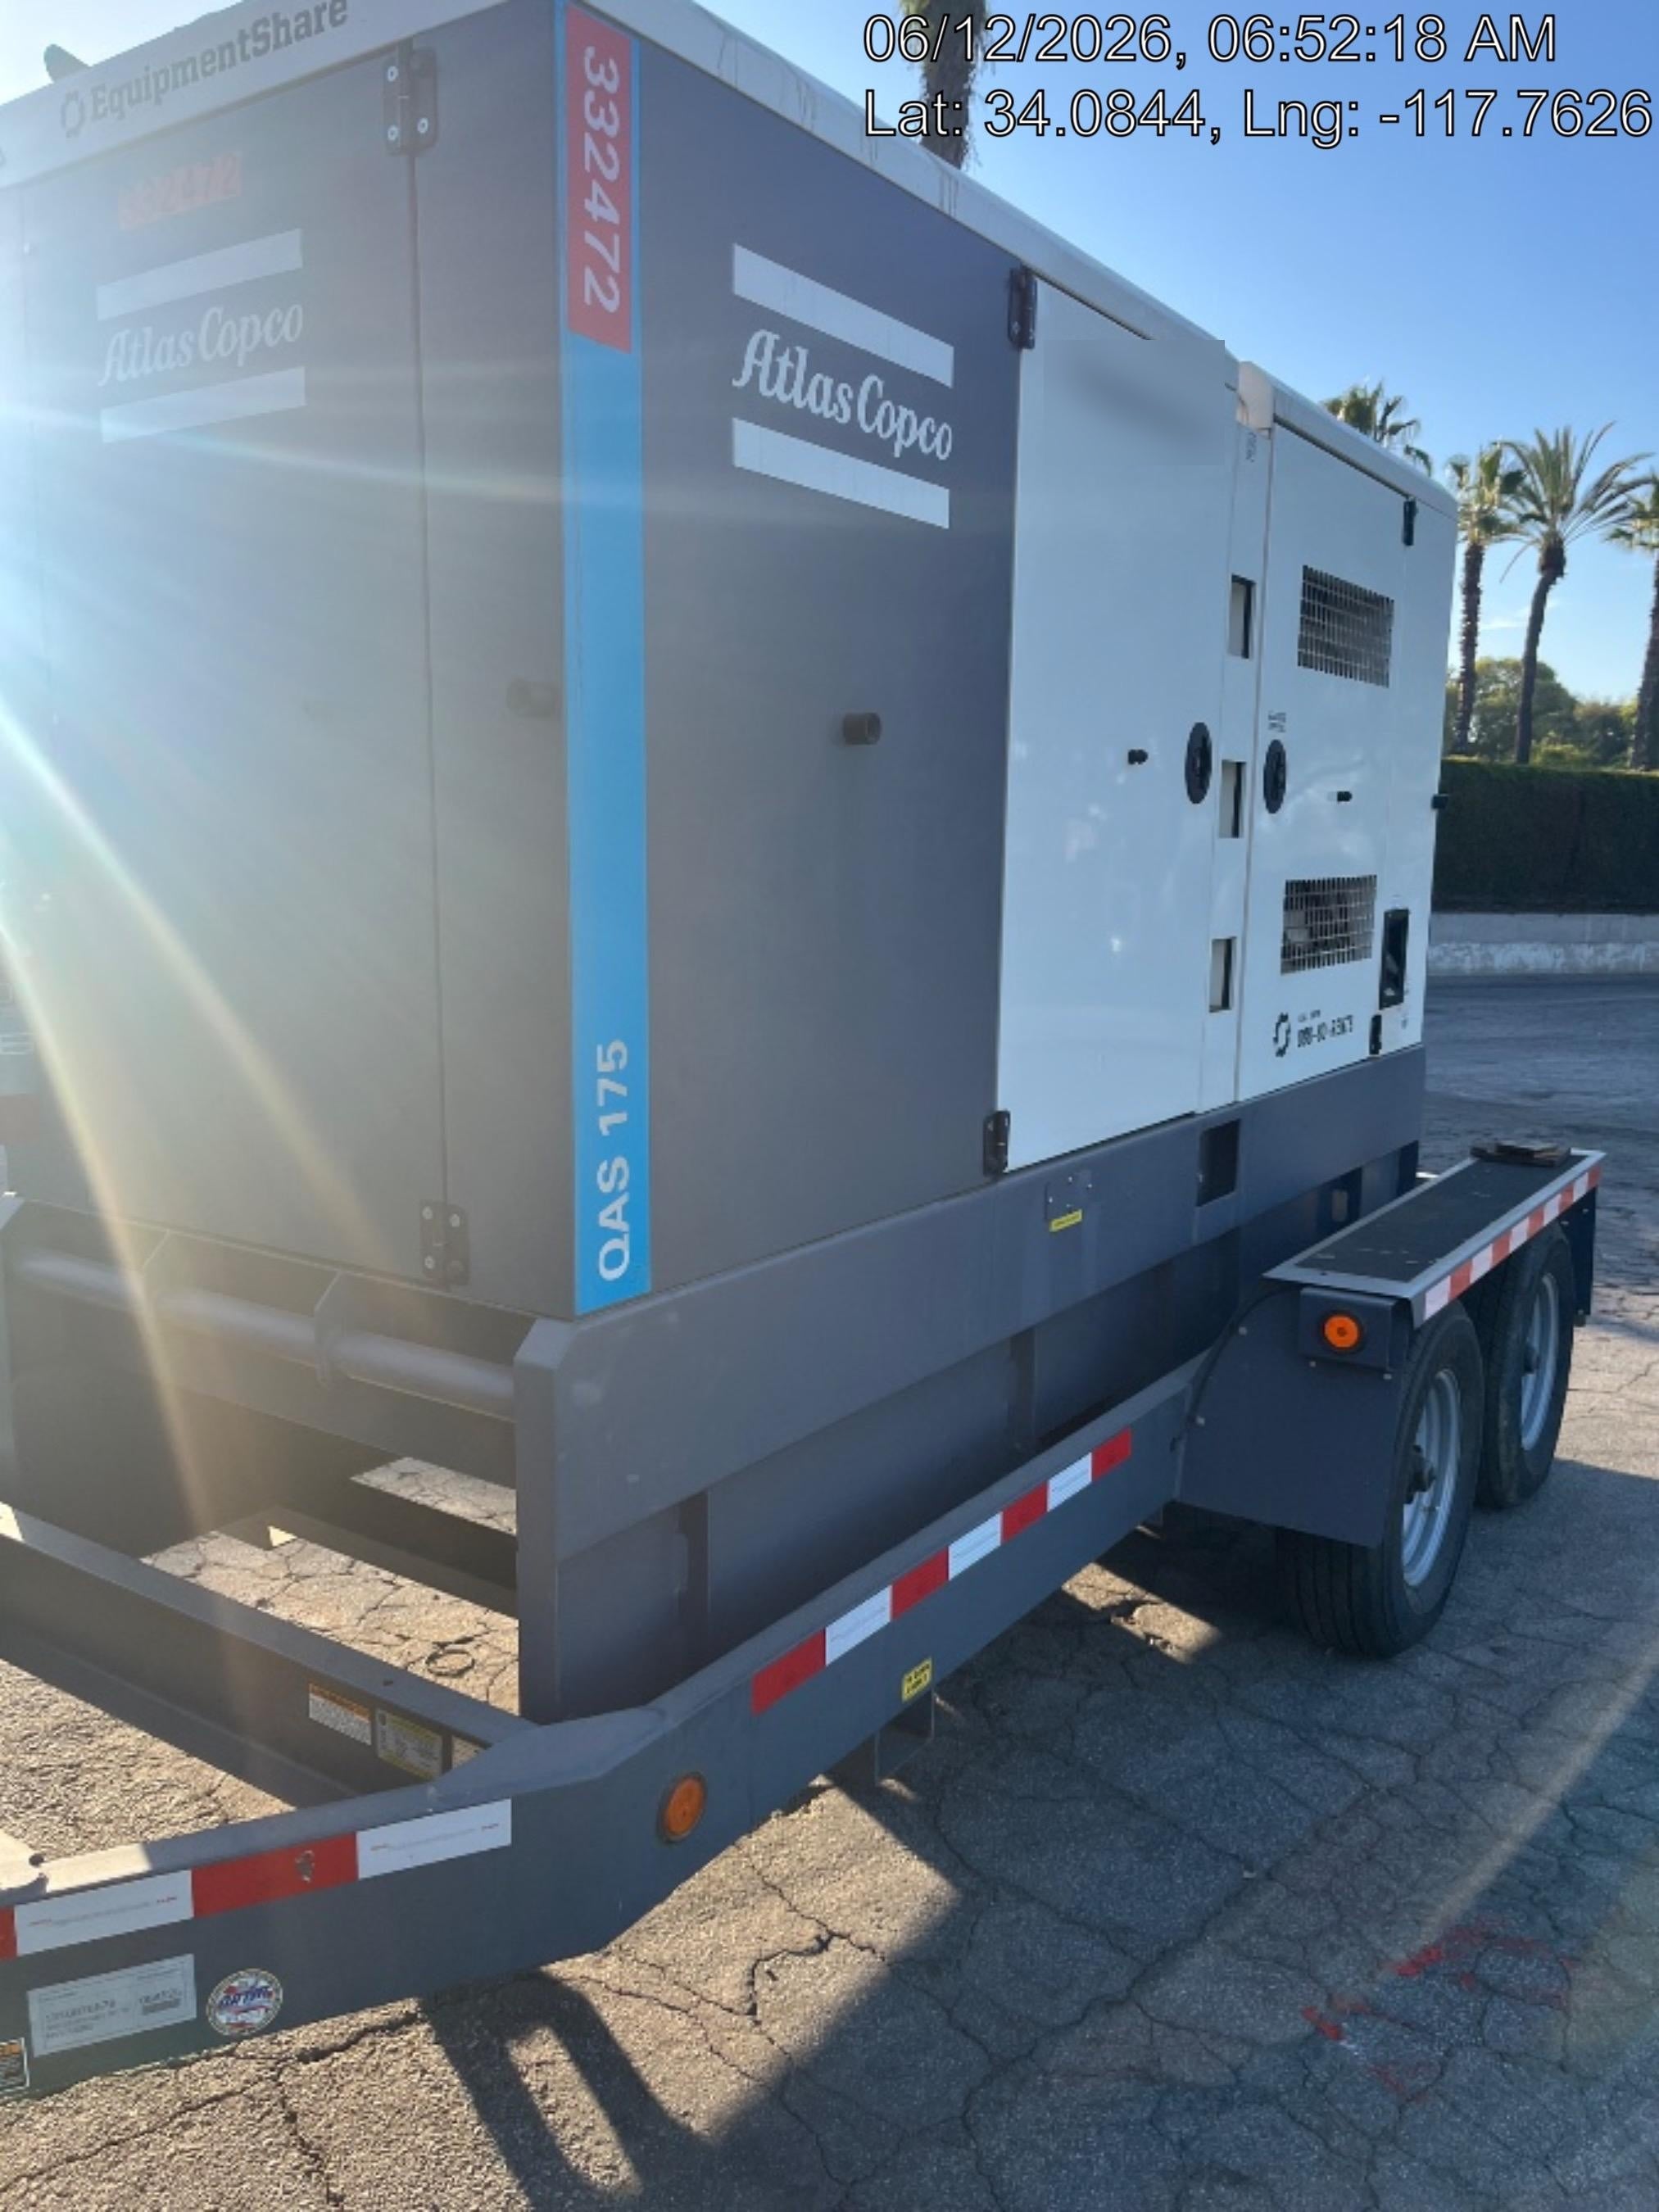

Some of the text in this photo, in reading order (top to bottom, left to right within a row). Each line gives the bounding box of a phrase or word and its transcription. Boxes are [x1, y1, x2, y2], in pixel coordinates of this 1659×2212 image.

[89, 0, 348, 120] EquipmentShare
[584, 45, 620, 314] 332472
[97, 304, 303, 387] Atlas Copco
[732, 329, 953, 460] Atlas Copco
[596, 1039, 630, 1281] QAS 175
